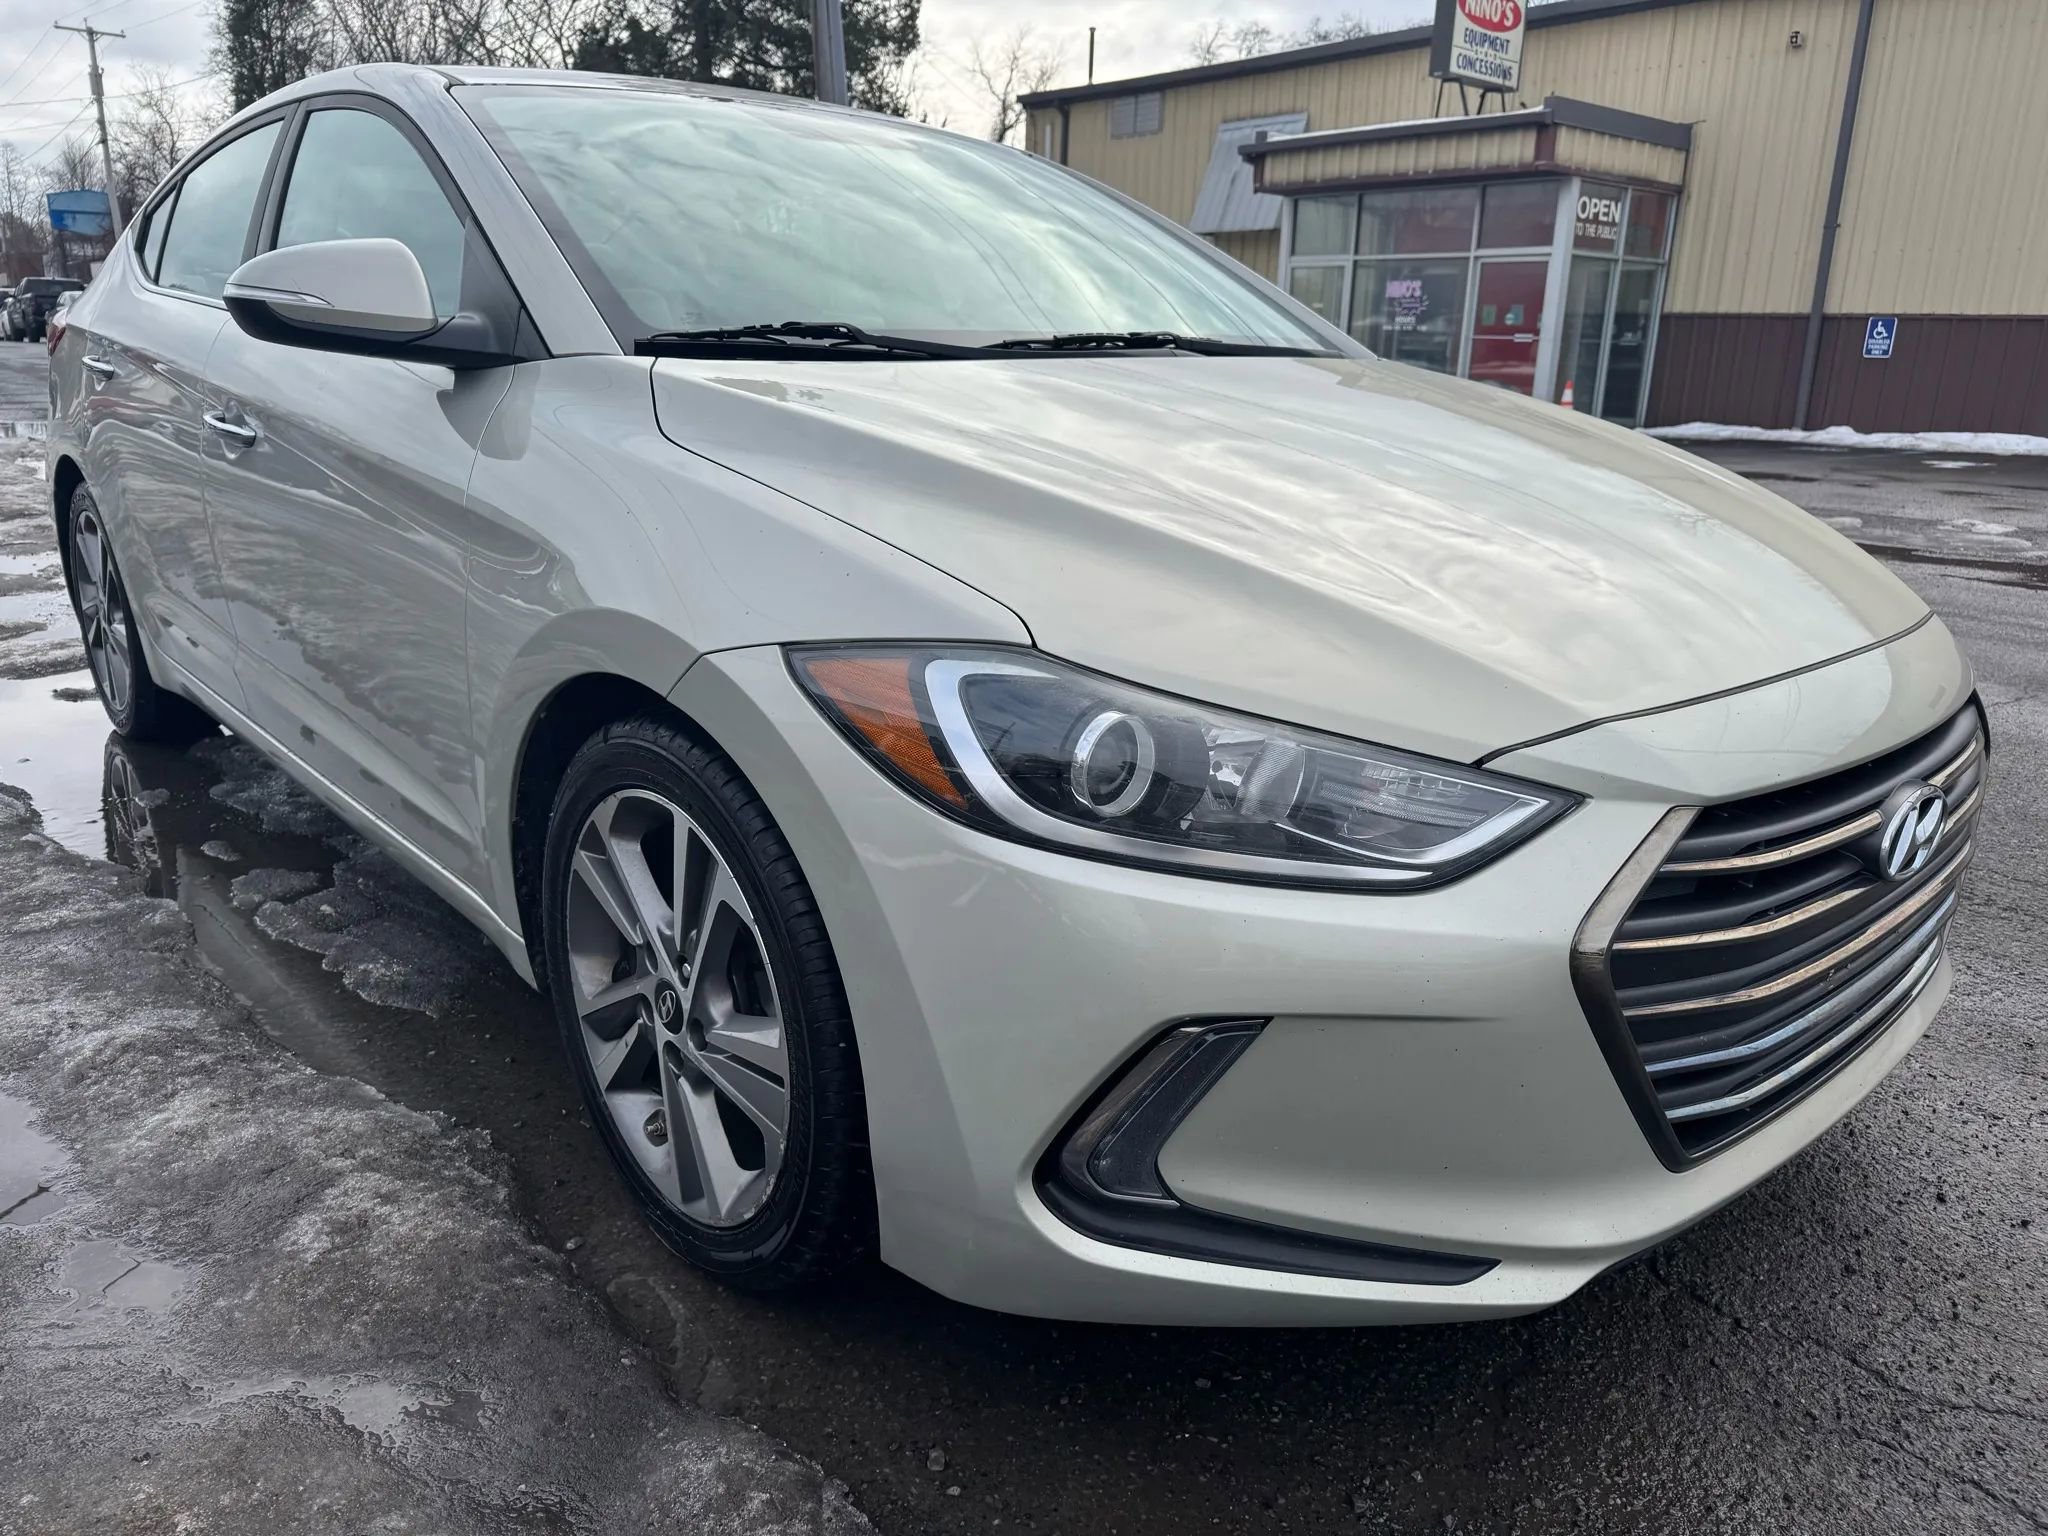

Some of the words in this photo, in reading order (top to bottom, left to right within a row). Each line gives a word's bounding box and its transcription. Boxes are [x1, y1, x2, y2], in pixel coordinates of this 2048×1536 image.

[1465, 0, 1514, 27] NINO'S
[1464, 27, 1510, 55] EQUIPMENT
[1456, 52, 1512, 81] CONCESSIONS
[1577, 195, 1621, 223] OPEN
[1575, 222, 1584, 236] TO
[1585, 223, 1597, 237] THE
[1597, 225, 1617, 240] PUBLIC
